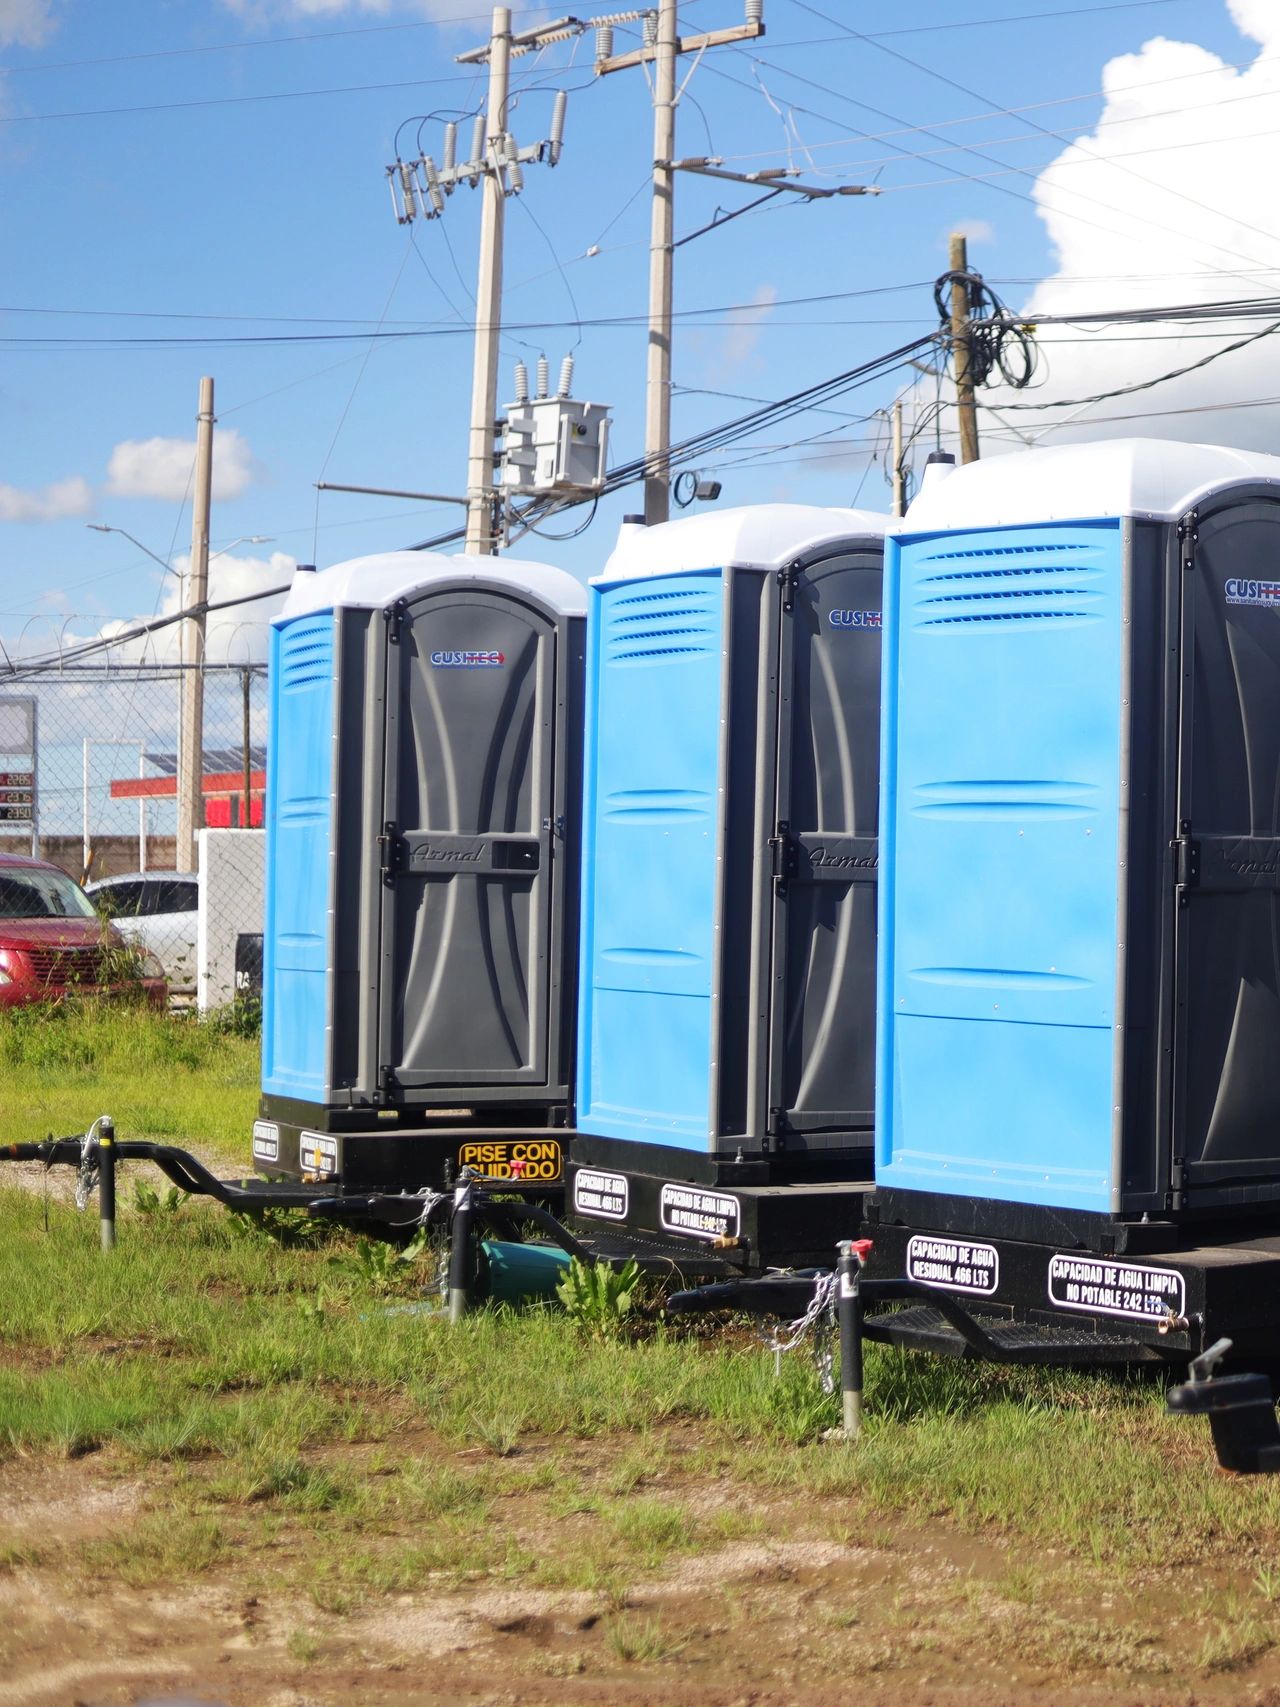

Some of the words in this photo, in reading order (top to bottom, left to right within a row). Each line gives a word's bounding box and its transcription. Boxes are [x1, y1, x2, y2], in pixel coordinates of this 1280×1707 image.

[829, 609, 882, 626] CUSIT
[431, 651, 502, 664] CUSITEC
[409, 842, 487, 863] Armal
[464, 1146, 507, 1162] PISE
[512, 1143, 555, 1161] CON
[912, 1240, 957, 1262] CAPACIDAD
[959, 1246, 970, 1264] DE
[971, 1249, 994, 1267] AGUA
[913, 1261, 953, 1281] RESIDUAL
[954, 1267, 971, 1284] 466
[973, 1269, 989, 1287] LTS
[1052, 1260, 1102, 1283] CAPACIDAD
[1104, 1267, 1117, 1285] DE
[1118, 1269, 1143, 1290] AGUA
[1144, 1273, 1178, 1294] LIMPIA
[1066, 1283, 1079, 1301] NO
[1081, 1285, 1121, 1308] POTABLE
[1123, 1291, 1142, 1311] 242
[1144, 1295, 1162, 1314] LTS
